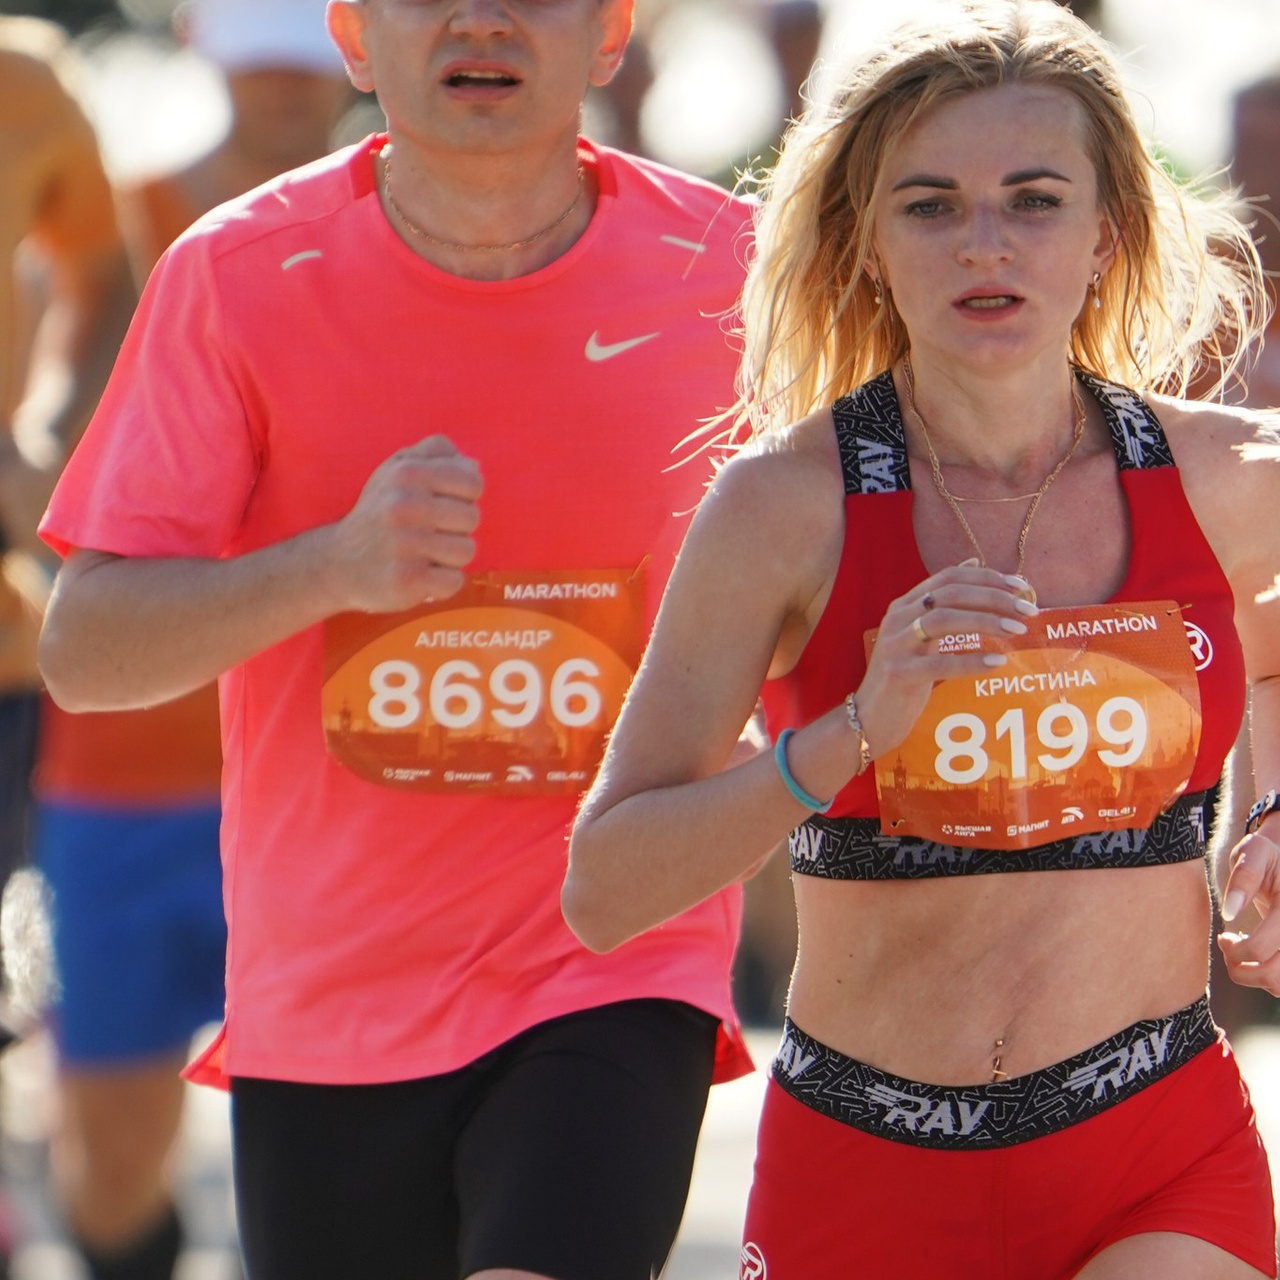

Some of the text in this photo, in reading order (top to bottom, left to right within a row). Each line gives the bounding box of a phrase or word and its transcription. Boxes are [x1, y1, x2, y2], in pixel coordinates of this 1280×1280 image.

[503, 582, 618, 600] MARATHON
[415, 630, 552, 649] АЛЕКСАНДР
[1046, 615, 1157, 640] MARATHON
[367, 658, 602, 729] 8696
[975, 669, 1097, 697] КРИСТИНА
[934, 696, 1147, 784] 8199
[1018, 820, 1050, 834] МАГНИТ
[776, 1036, 816, 1079] AY
[1061, 1020, 1174, 1100] RAY
[864, 1083, 992, 1136] RAY
